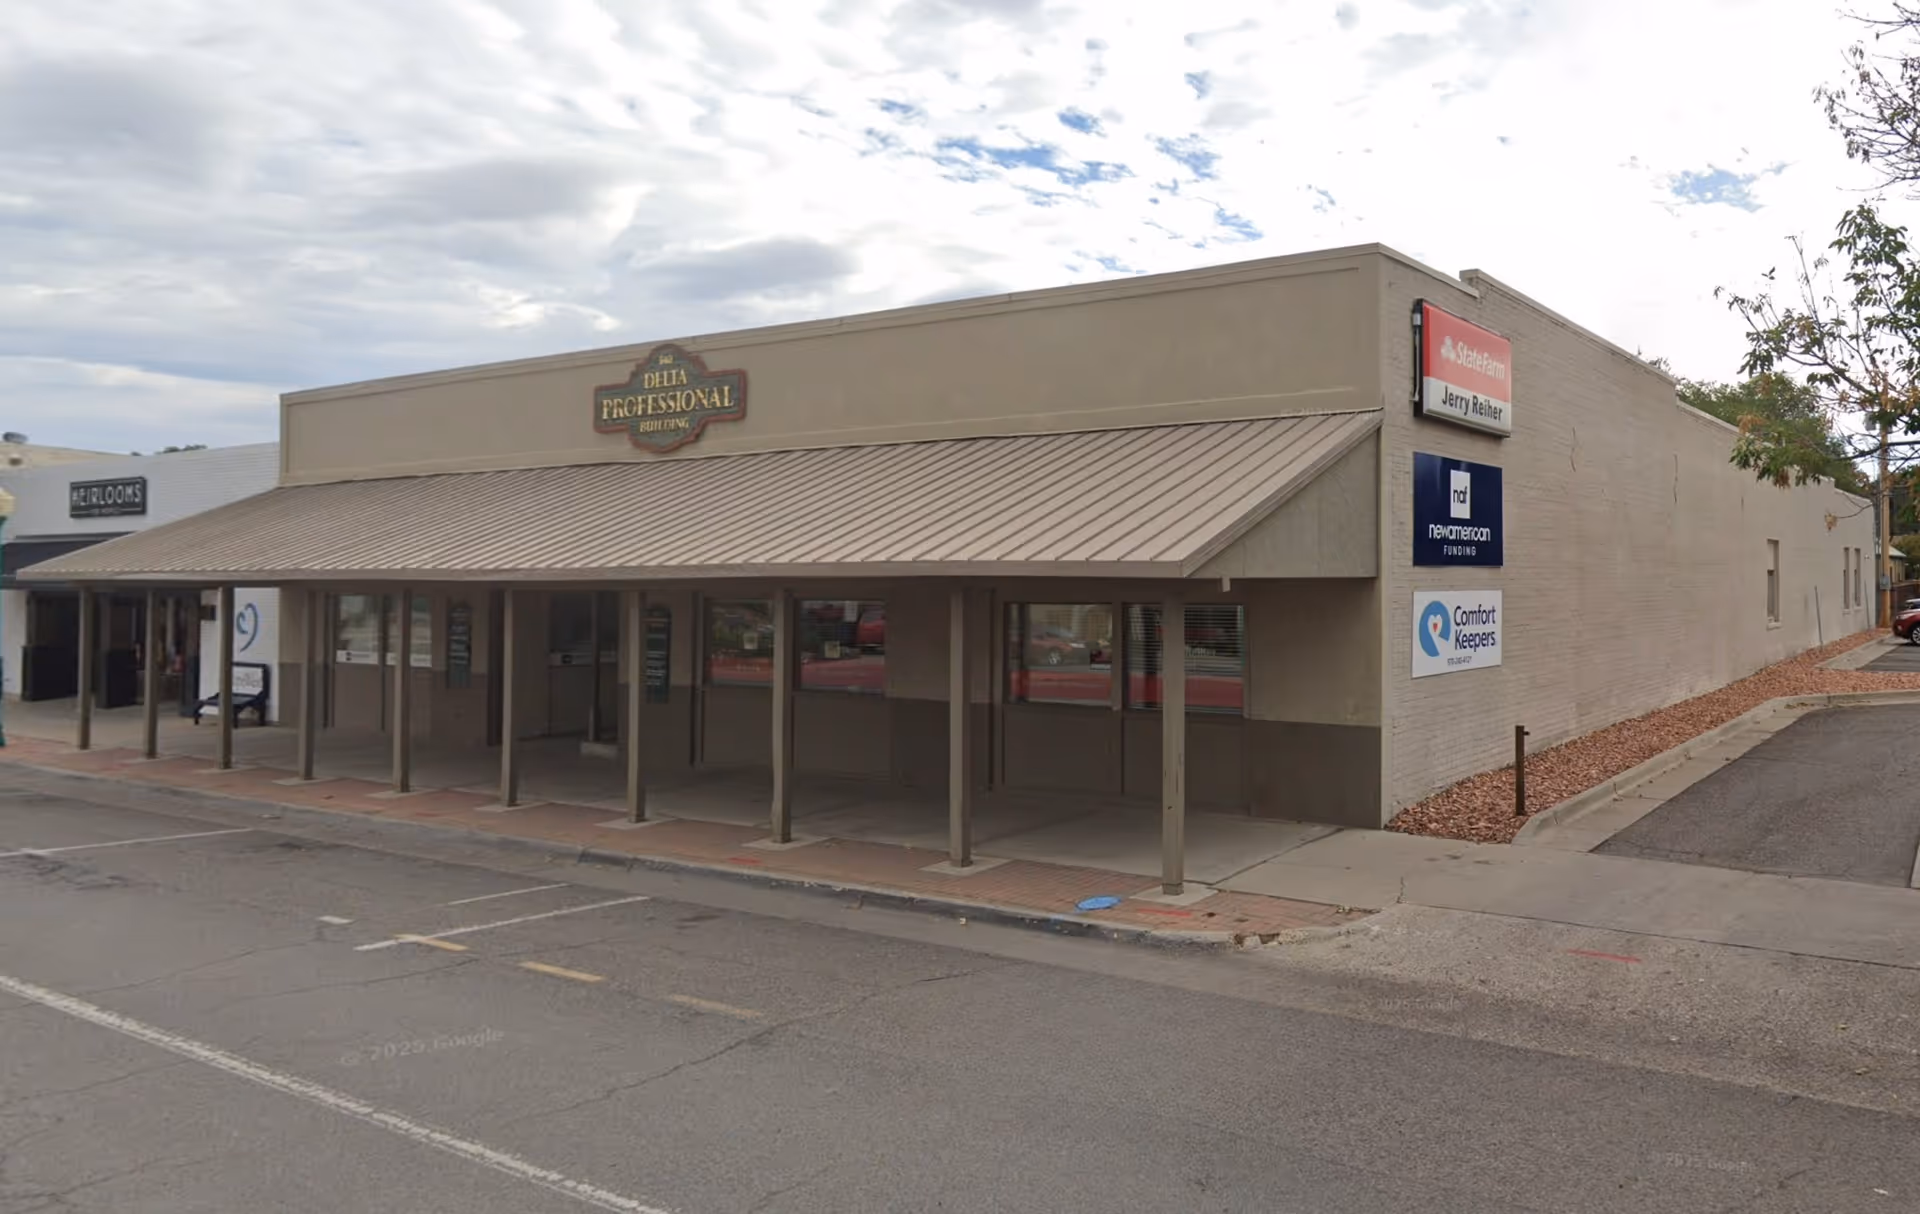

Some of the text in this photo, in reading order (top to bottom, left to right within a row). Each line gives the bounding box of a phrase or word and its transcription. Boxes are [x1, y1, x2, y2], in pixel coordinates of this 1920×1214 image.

[643, 368, 688, 389] DELTA
[601, 385, 734, 420] PROFESSIONAL
[1441, 386, 1503, 422] Jerry Reiher
[639, 417, 690, 433] BUILDING
[72, 484, 142, 506] HEIRLOOMS
[1452, 486, 1468, 505] naf
[1443, 545, 1477, 556] FUNDING
[1453, 604, 1496, 627] Comfort
[1454, 630, 1497, 652] Keepers
